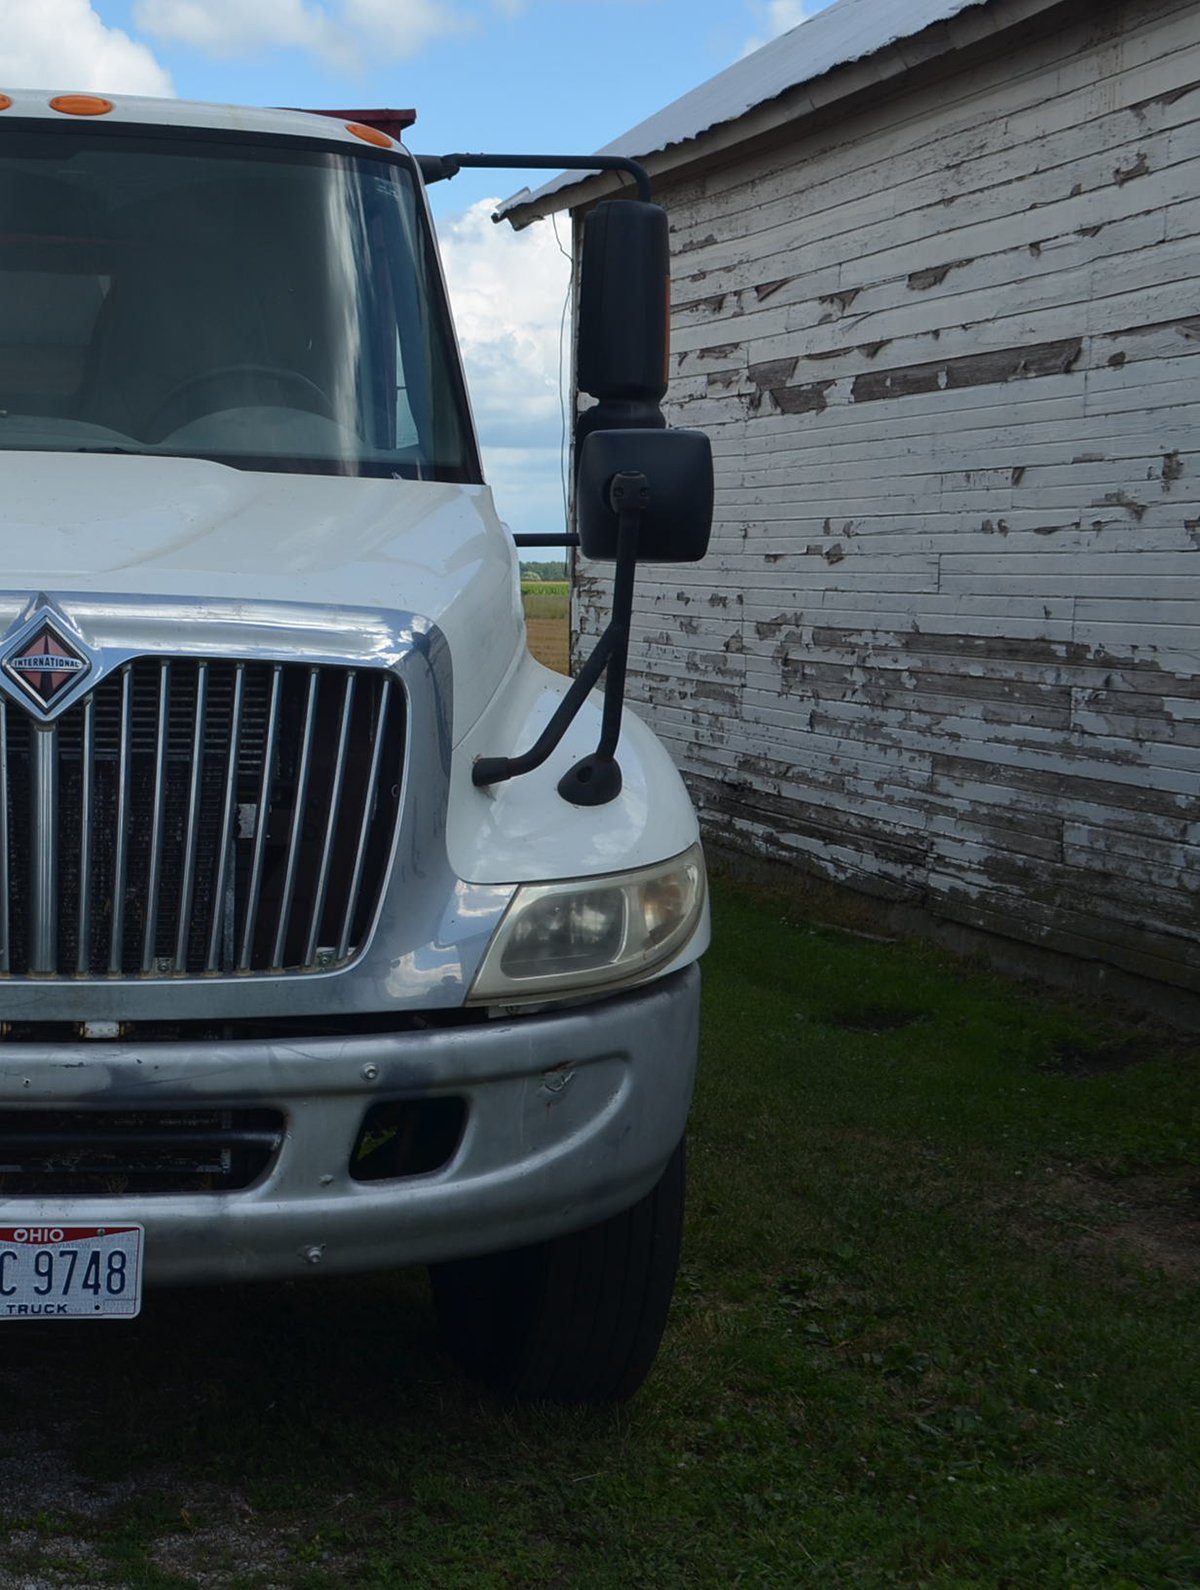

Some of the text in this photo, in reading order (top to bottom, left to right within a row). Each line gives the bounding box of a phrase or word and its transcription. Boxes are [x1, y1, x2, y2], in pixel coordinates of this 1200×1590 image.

[13, 657, 80, 668] INTERNATIONAL
[13, 1228, 64, 1242] OHIO
[33, 1250, 127, 1296] 9748
[6, 1304, 68, 1314] TRUCK
